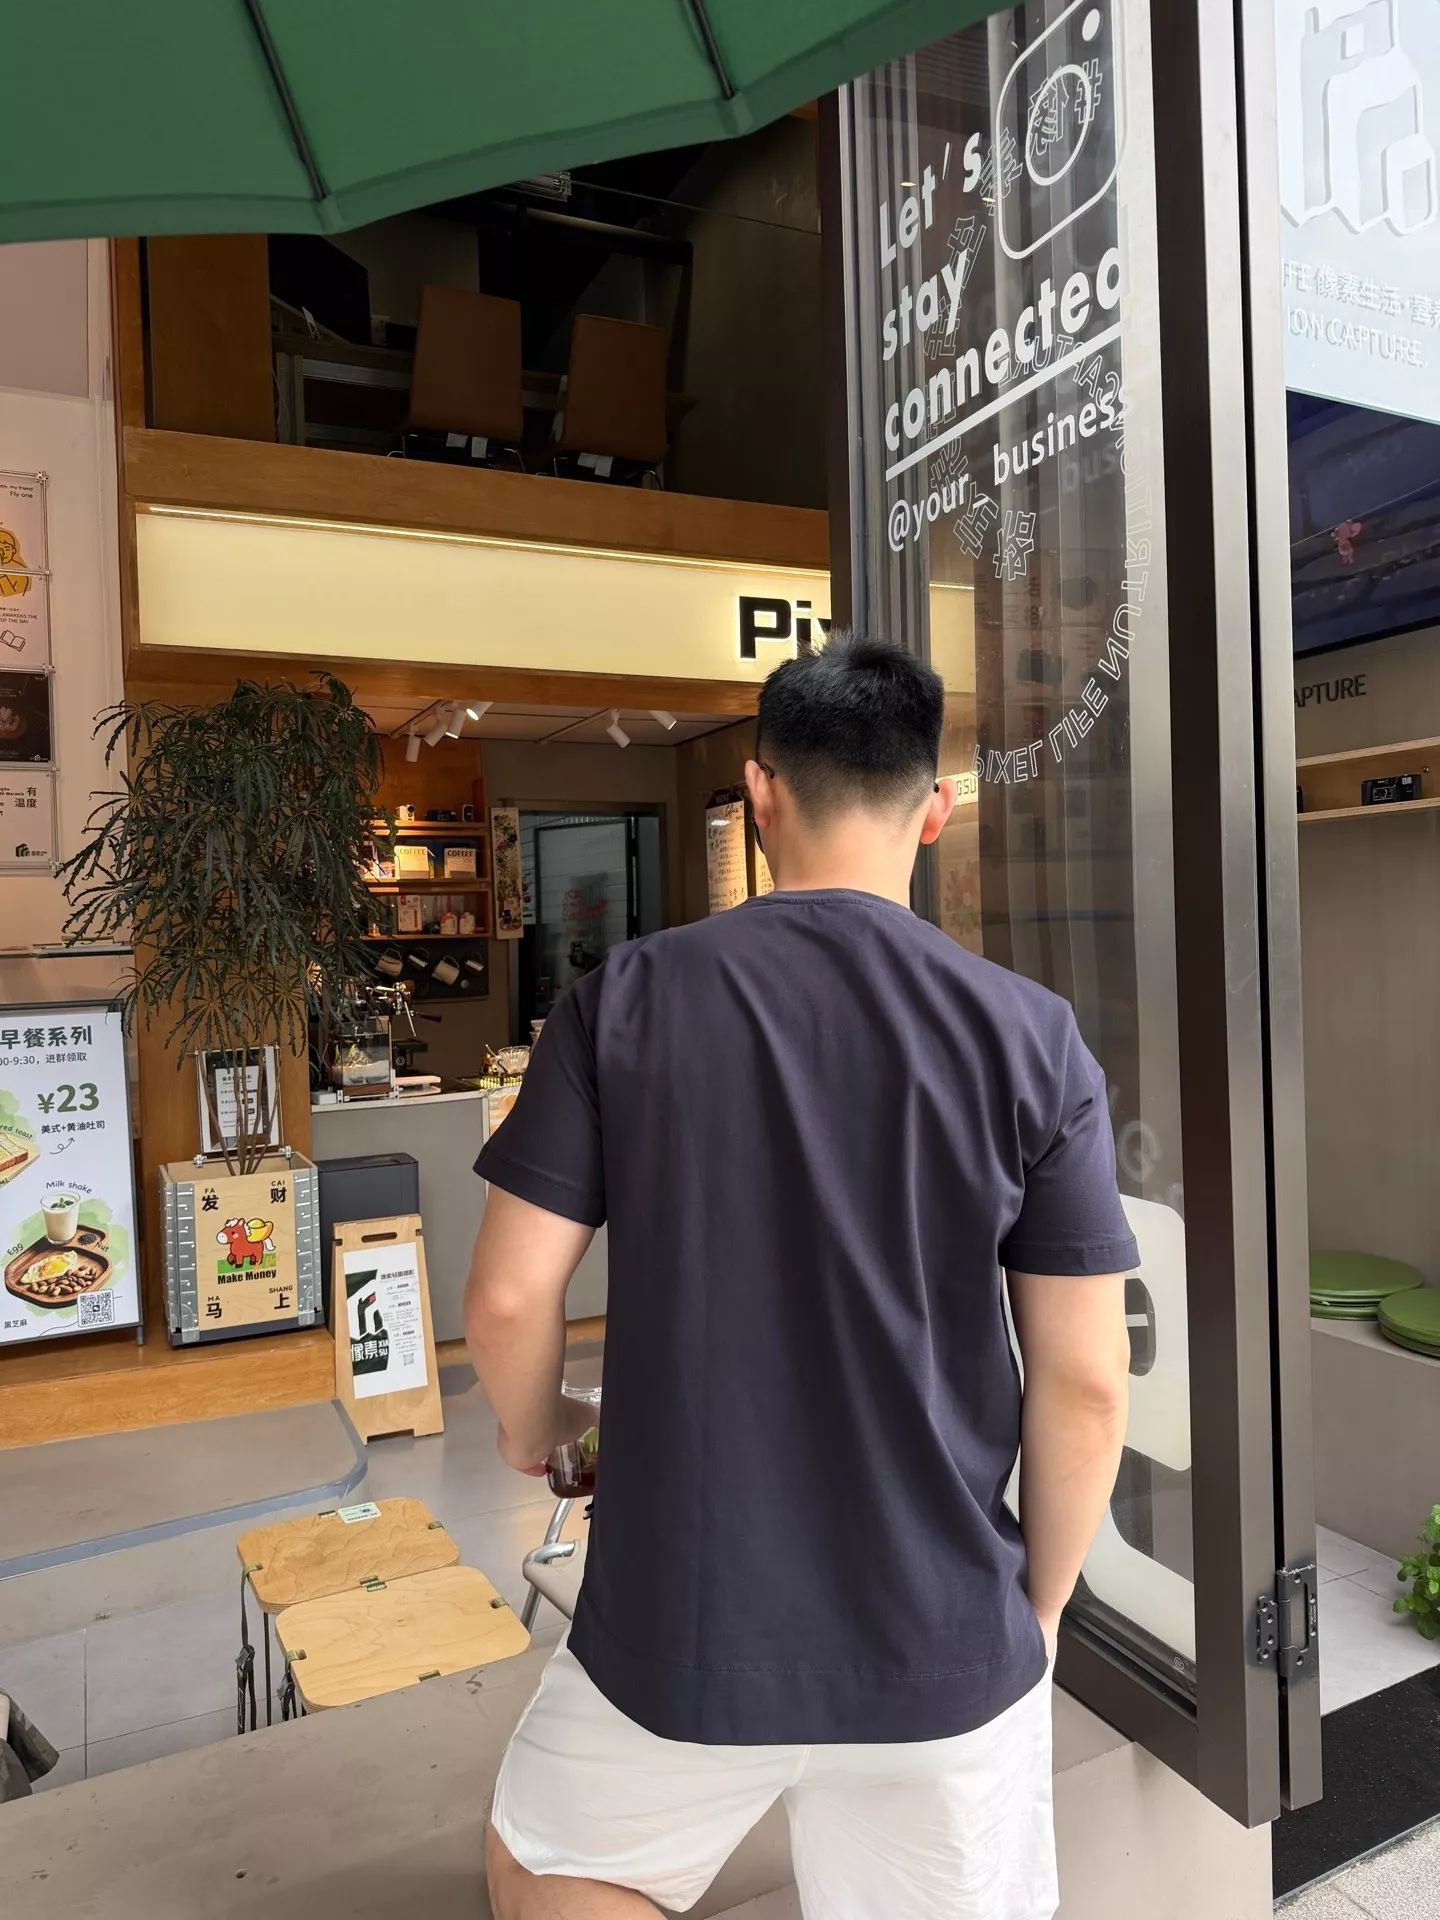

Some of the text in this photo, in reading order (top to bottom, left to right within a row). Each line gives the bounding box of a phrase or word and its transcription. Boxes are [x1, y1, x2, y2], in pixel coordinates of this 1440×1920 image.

[882, 248, 968, 361] stay
[738, 595, 831, 660] Pi
[27, 786, 37, 797] 有
[14, 797, 37, 808] 温度
[400, 848, 427, 856] COFFEE
[0, 1025, 93, 1050] 早餐系列
[37, 1082, 100, 1114] ¥23
[15, 1127, 33, 1140] toast
[41, 1120, 105, 1135] 美式+黄油吐司
[46, 1180, 93, 1194] Milk shake
[204, 1187, 216, 1195] FA
[270, 1186, 287, 1204] 财
[202, 1194, 219, 1212] 发
[7, 1243, 24, 1256] Egg
[95, 1241, 110, 1253] Nut
[217, 1268, 277, 1285] Make Money
[269, 1284, 293, 1294] SHANG
[274, 1292, 291, 1310] 上
[205, 1301, 222, 1319] 马
[351, 1340, 378, 1362] 像素
